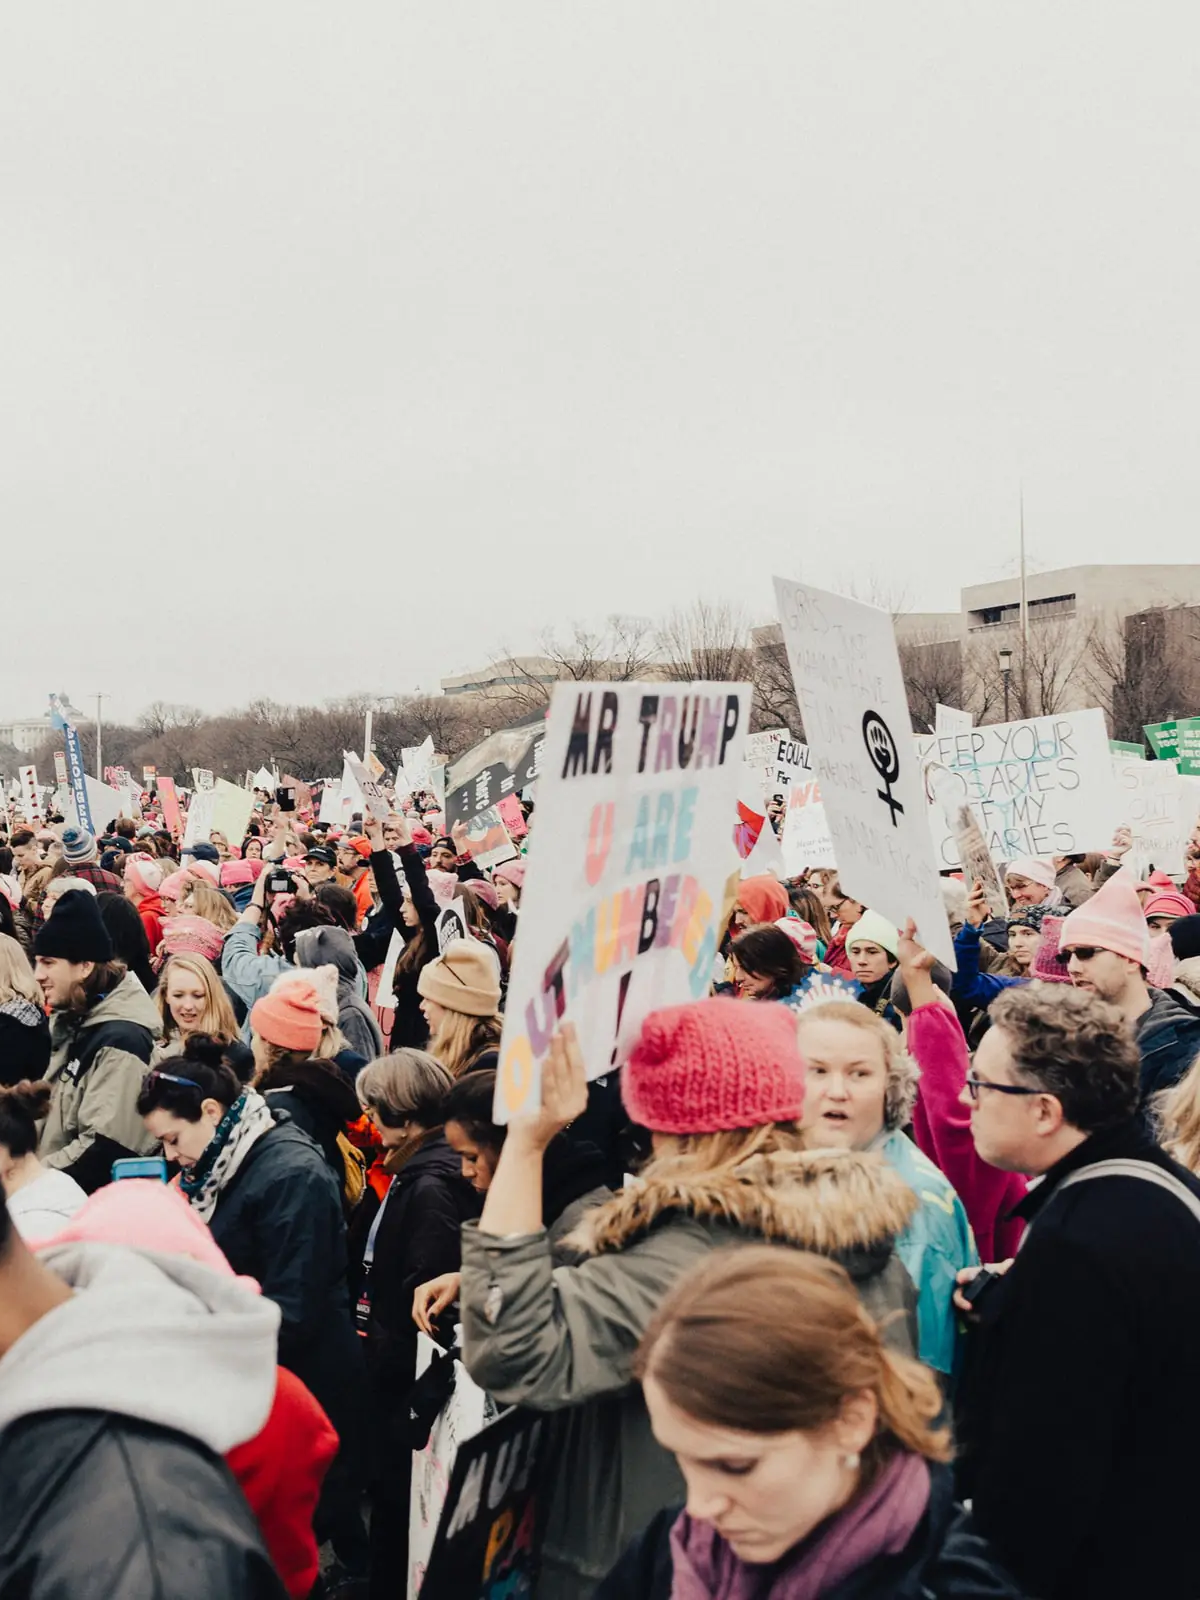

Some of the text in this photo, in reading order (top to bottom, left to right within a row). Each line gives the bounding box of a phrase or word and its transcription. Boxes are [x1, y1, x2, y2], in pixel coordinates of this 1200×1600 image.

[562, 691, 739, 779] MR TRUMP
[777, 739, 813, 770] EQUAL
[993, 721, 1078, 763] YOUR
[66, 728, 90, 830] STRONGER
[475, 769, 493, 811] there
[499, 773, 516, 794] in
[1012, 793, 1046, 828] MY
[584, 786, 699, 886] U ARE
